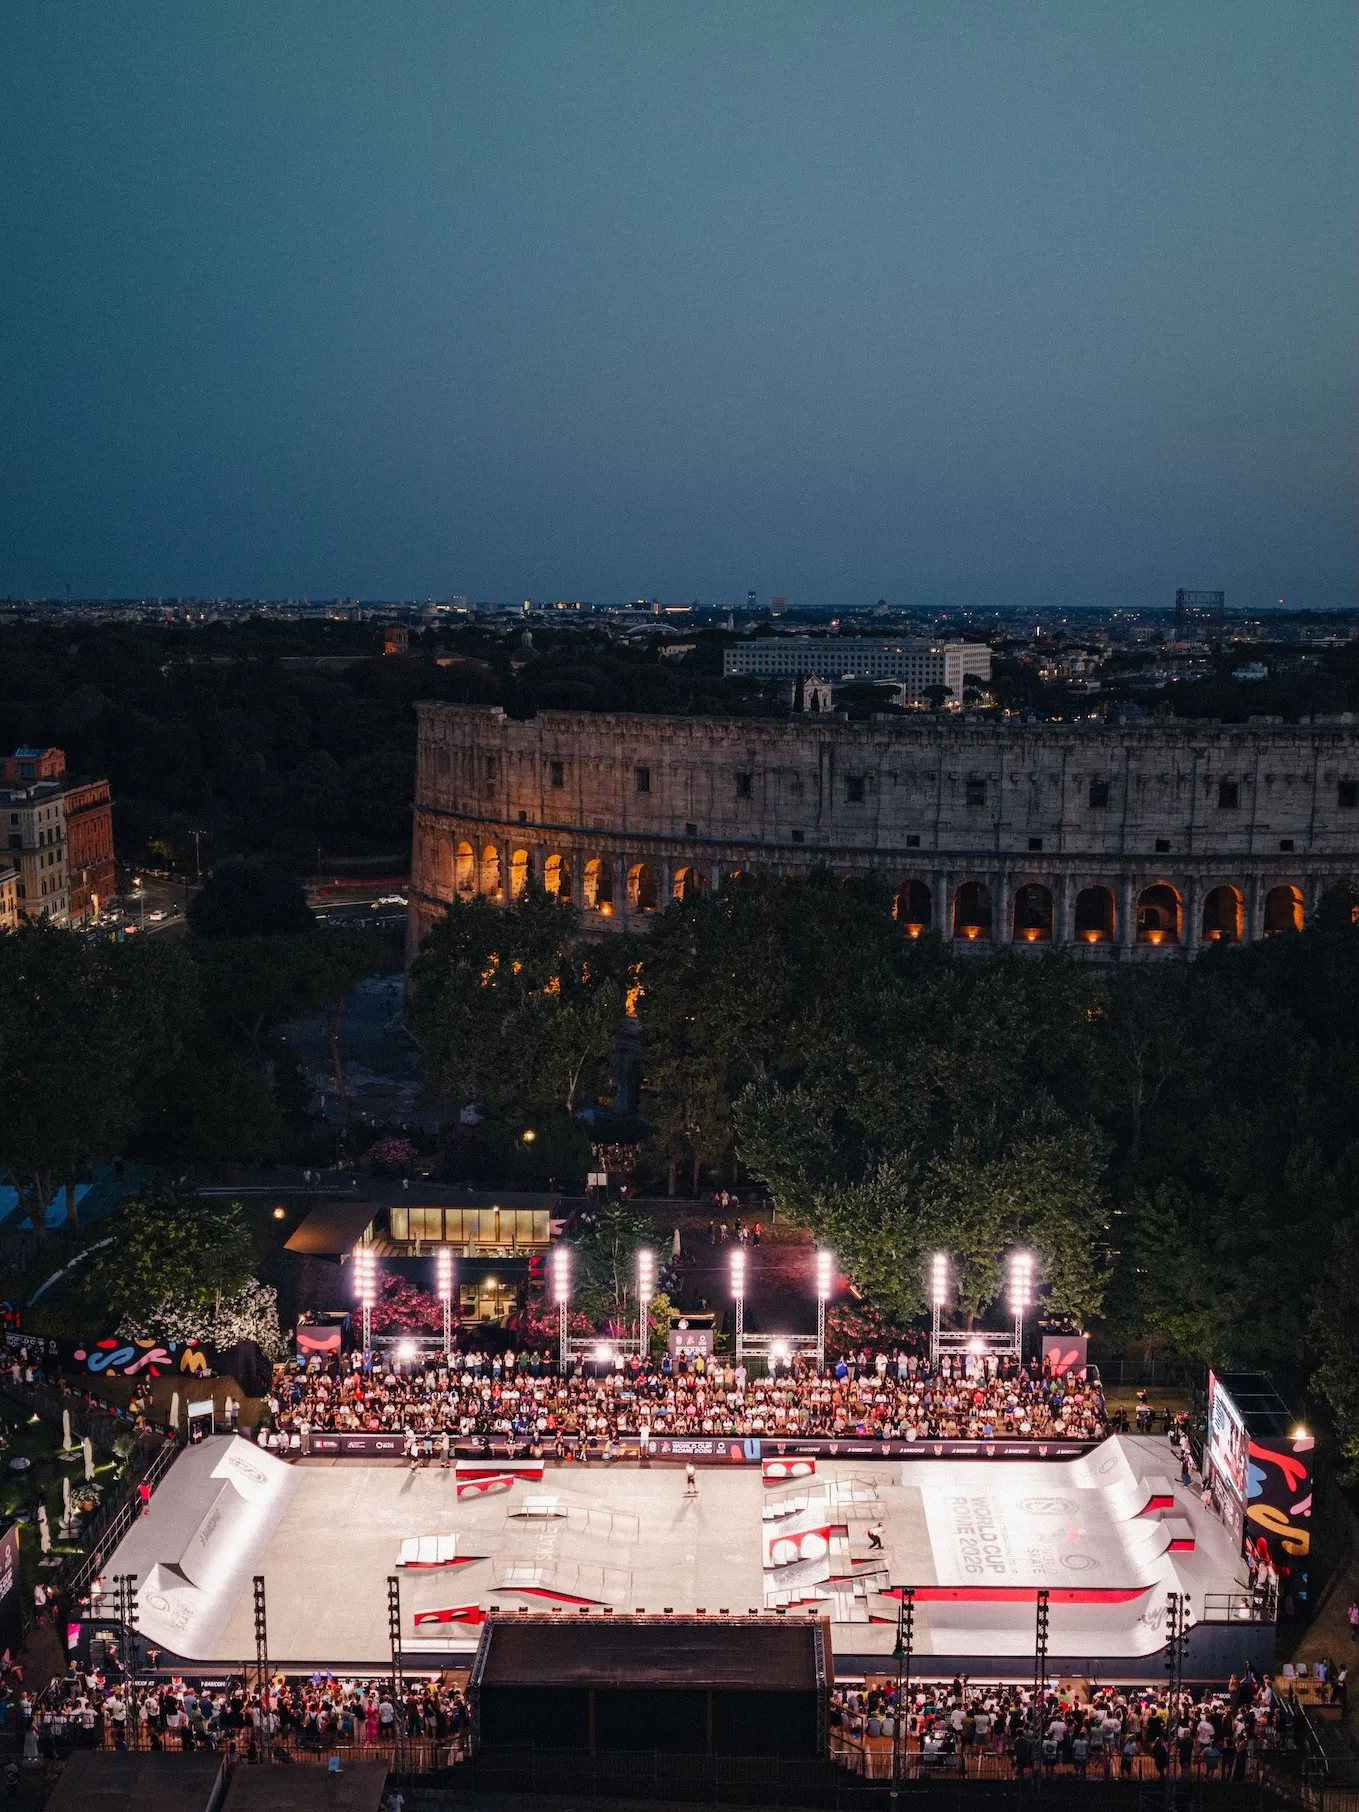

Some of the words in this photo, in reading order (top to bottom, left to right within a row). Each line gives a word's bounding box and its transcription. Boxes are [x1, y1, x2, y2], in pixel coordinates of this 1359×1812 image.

[970, 1496, 997, 1541] WORLD
[959, 1538, 984, 1573] 2026
[982, 1545, 1006, 1573] CUP
[1026, 1548, 1046, 1573] SKATE
